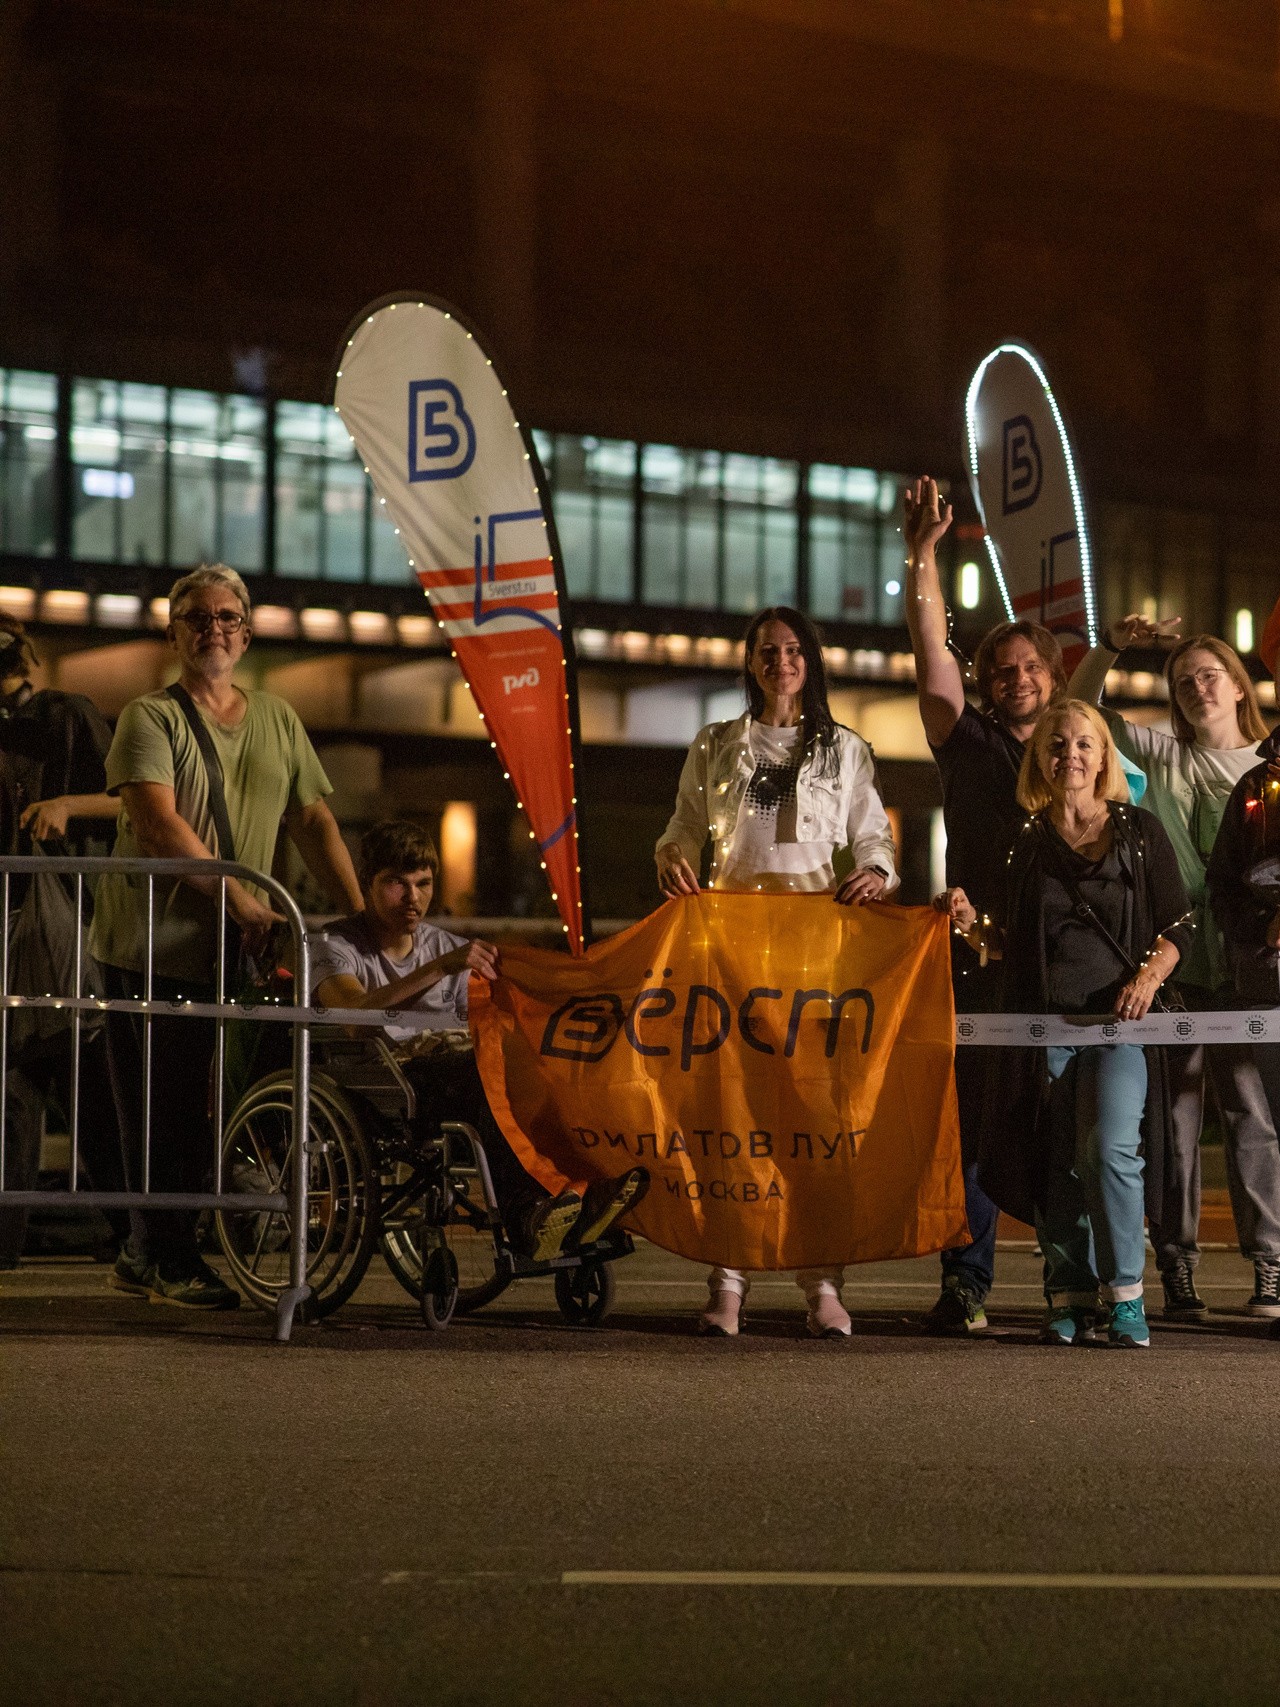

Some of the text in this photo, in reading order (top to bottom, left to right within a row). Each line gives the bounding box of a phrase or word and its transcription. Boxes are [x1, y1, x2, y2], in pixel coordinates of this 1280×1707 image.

[572, 1126, 867, 1160] ФИЛАТОВ ЛУГ
[663, 1175, 785, 1202] МОСКВА
